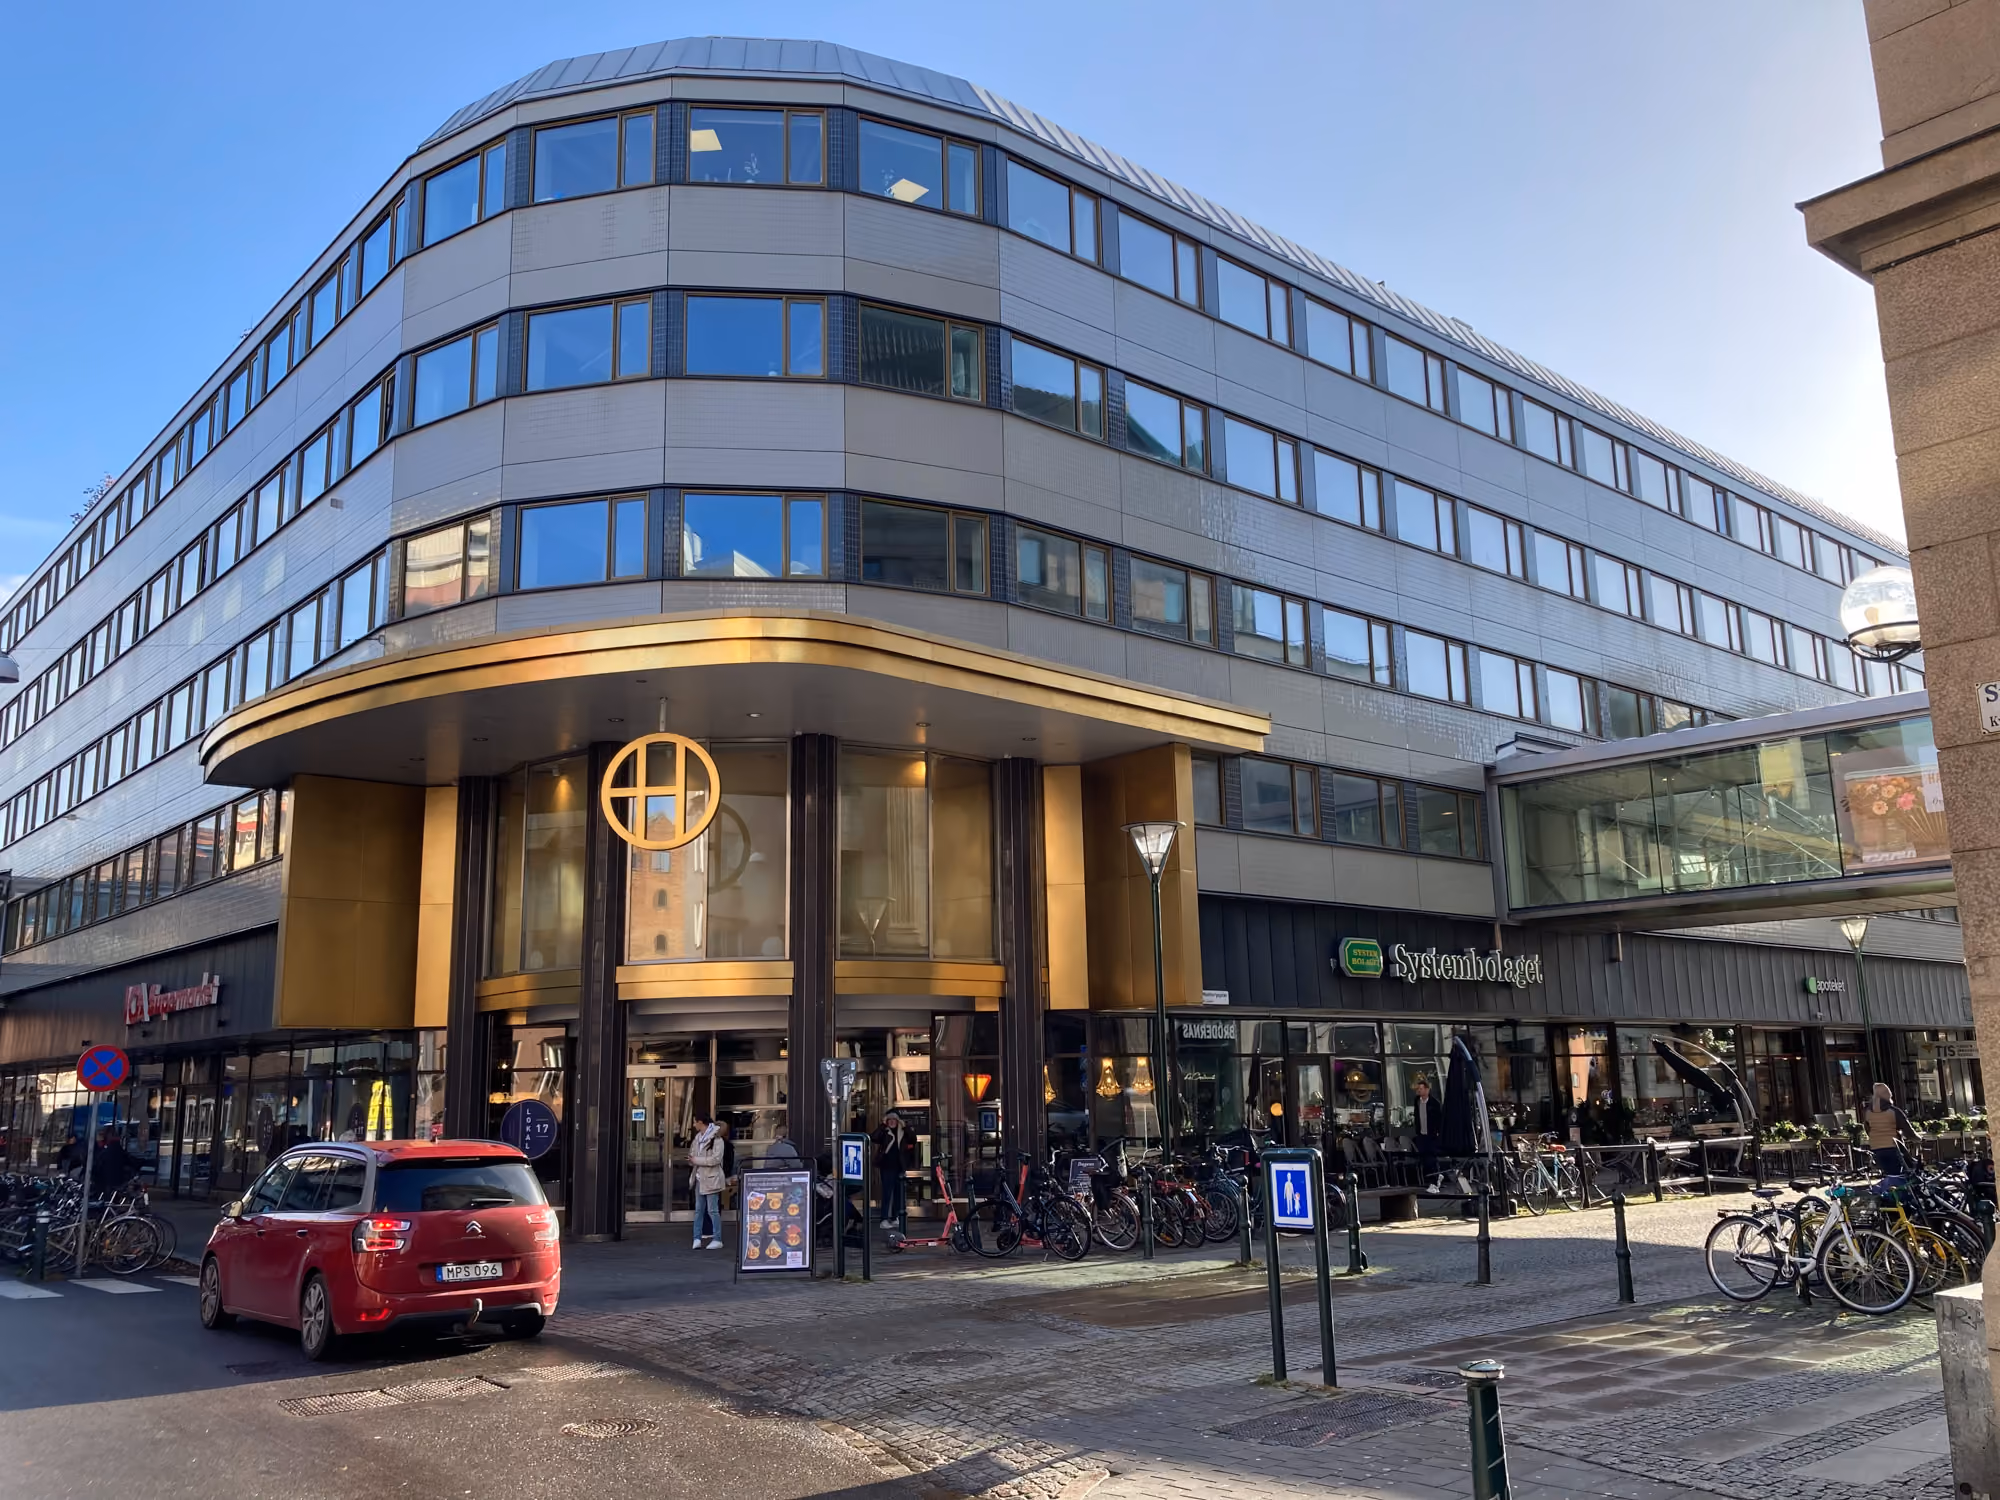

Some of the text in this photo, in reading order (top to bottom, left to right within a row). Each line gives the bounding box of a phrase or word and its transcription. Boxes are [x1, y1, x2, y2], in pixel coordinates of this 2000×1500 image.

[1391, 943, 1543, 988] Systembolaget
[1816, 979, 1846, 994] apoteket
[1935, 1045, 1956, 1057] TIS
[536, 1124, 549, 1134] 17
[446, 1263, 499, 1279] MPS 096
